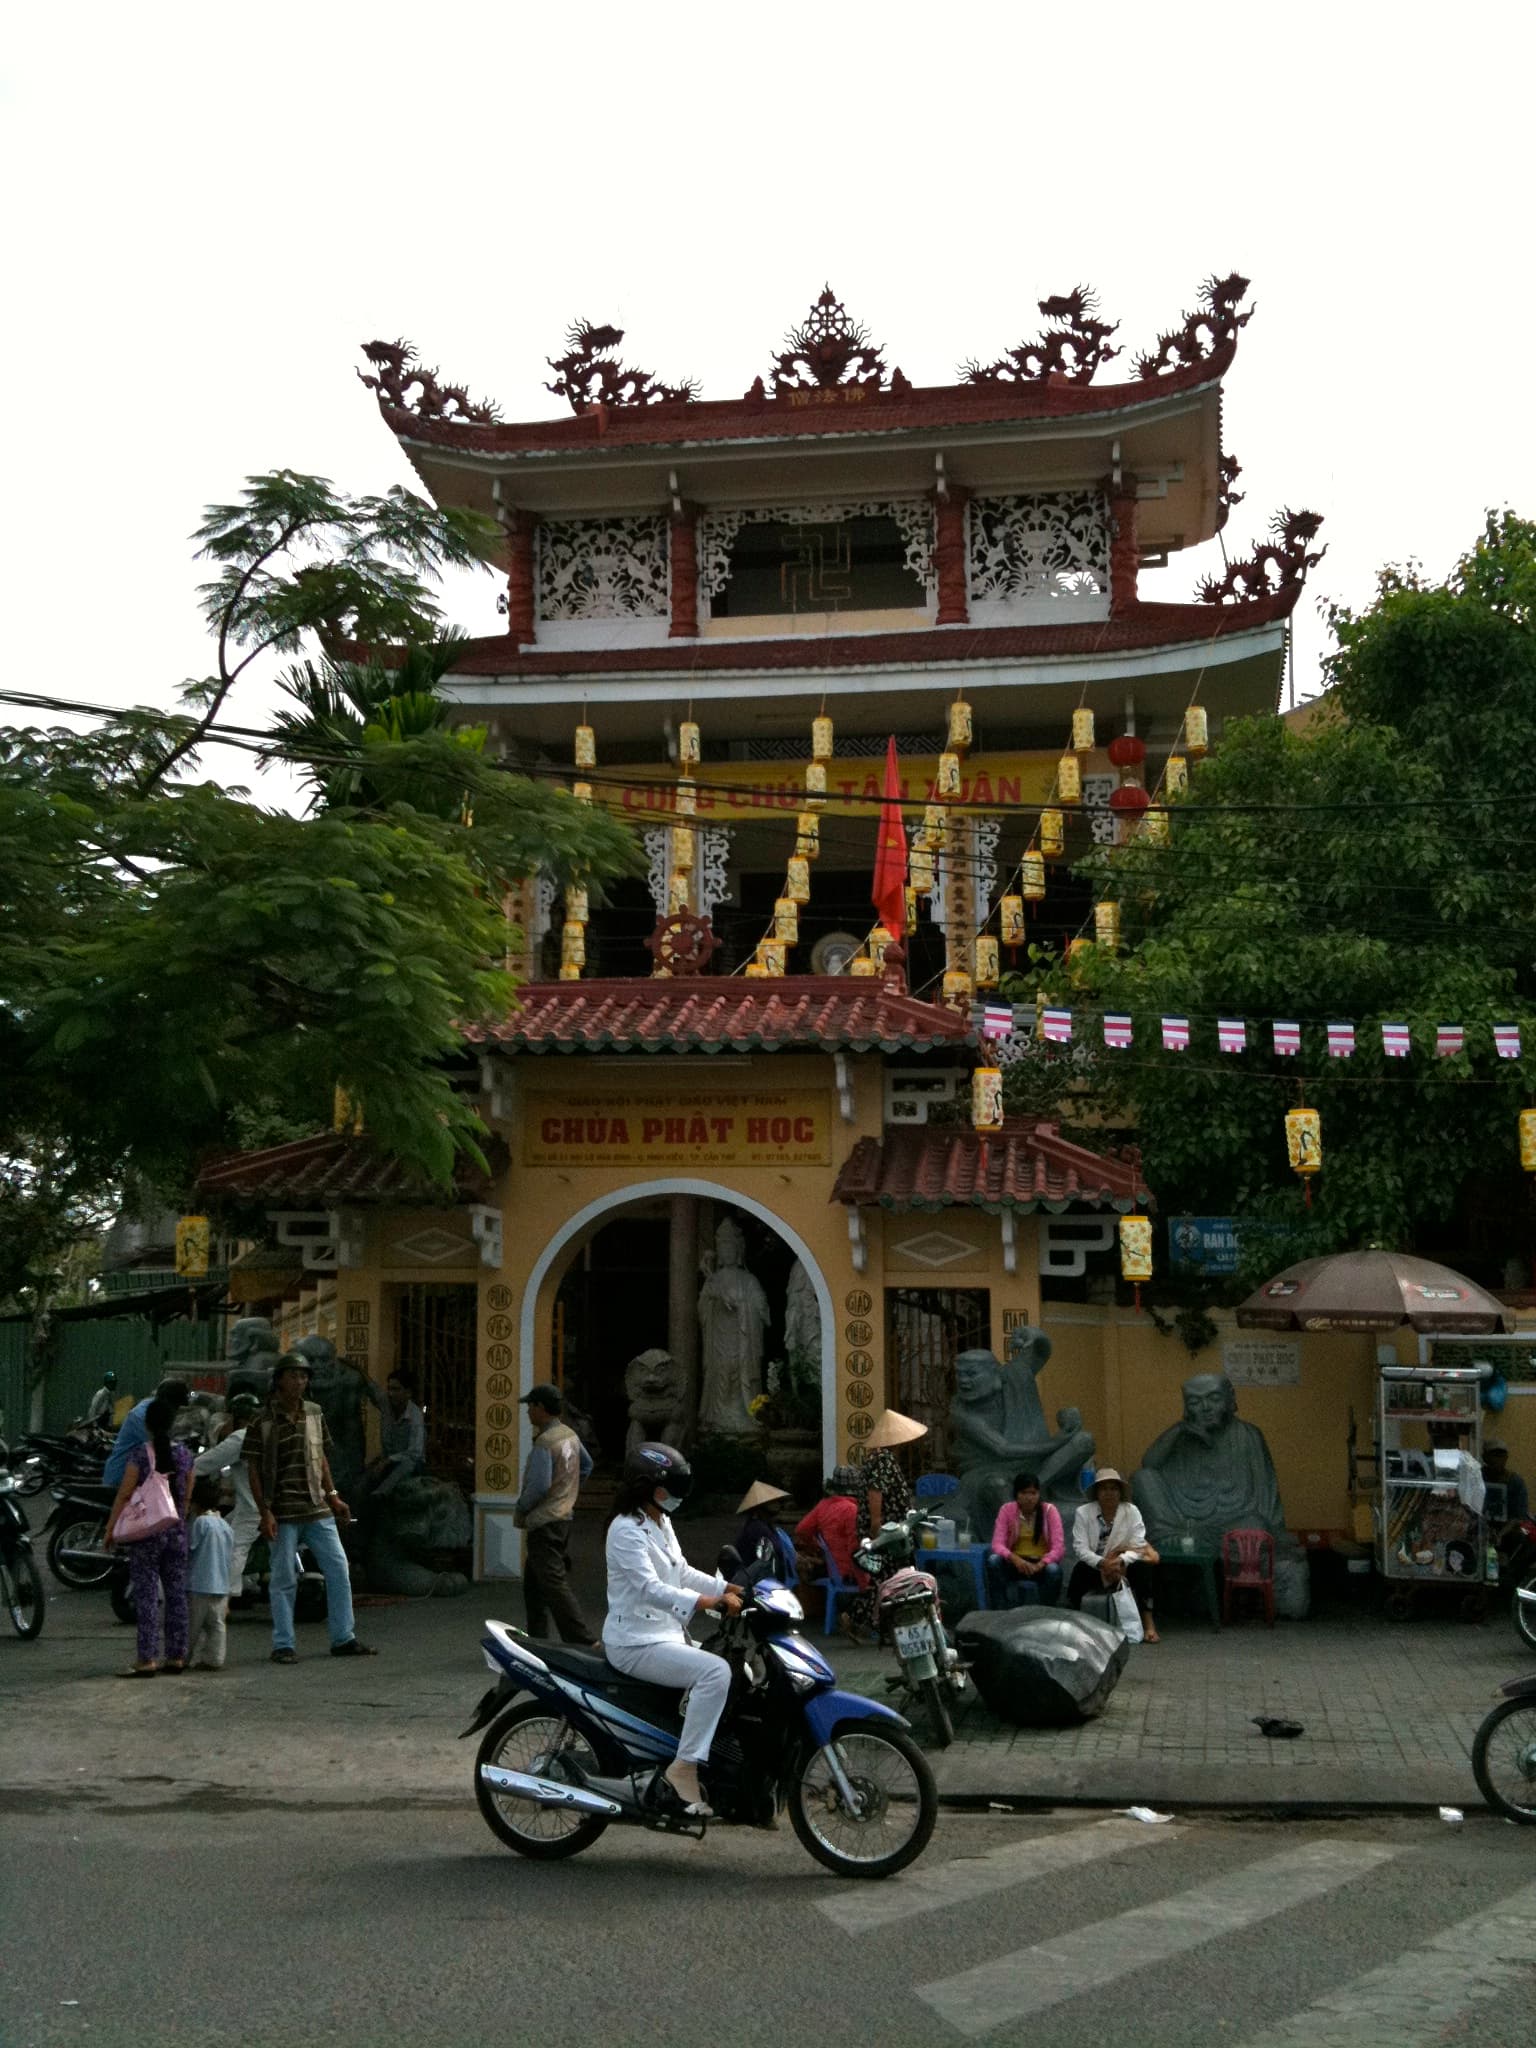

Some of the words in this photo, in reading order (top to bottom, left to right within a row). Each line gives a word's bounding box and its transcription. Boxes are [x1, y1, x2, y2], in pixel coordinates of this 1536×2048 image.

[727, 775, 822, 810] CHÚ
[541, 1110, 631, 1144] CHÙA
[641, 1111, 735, 1151] PHẬT
[747, 1117, 815, 1151] HỌC
